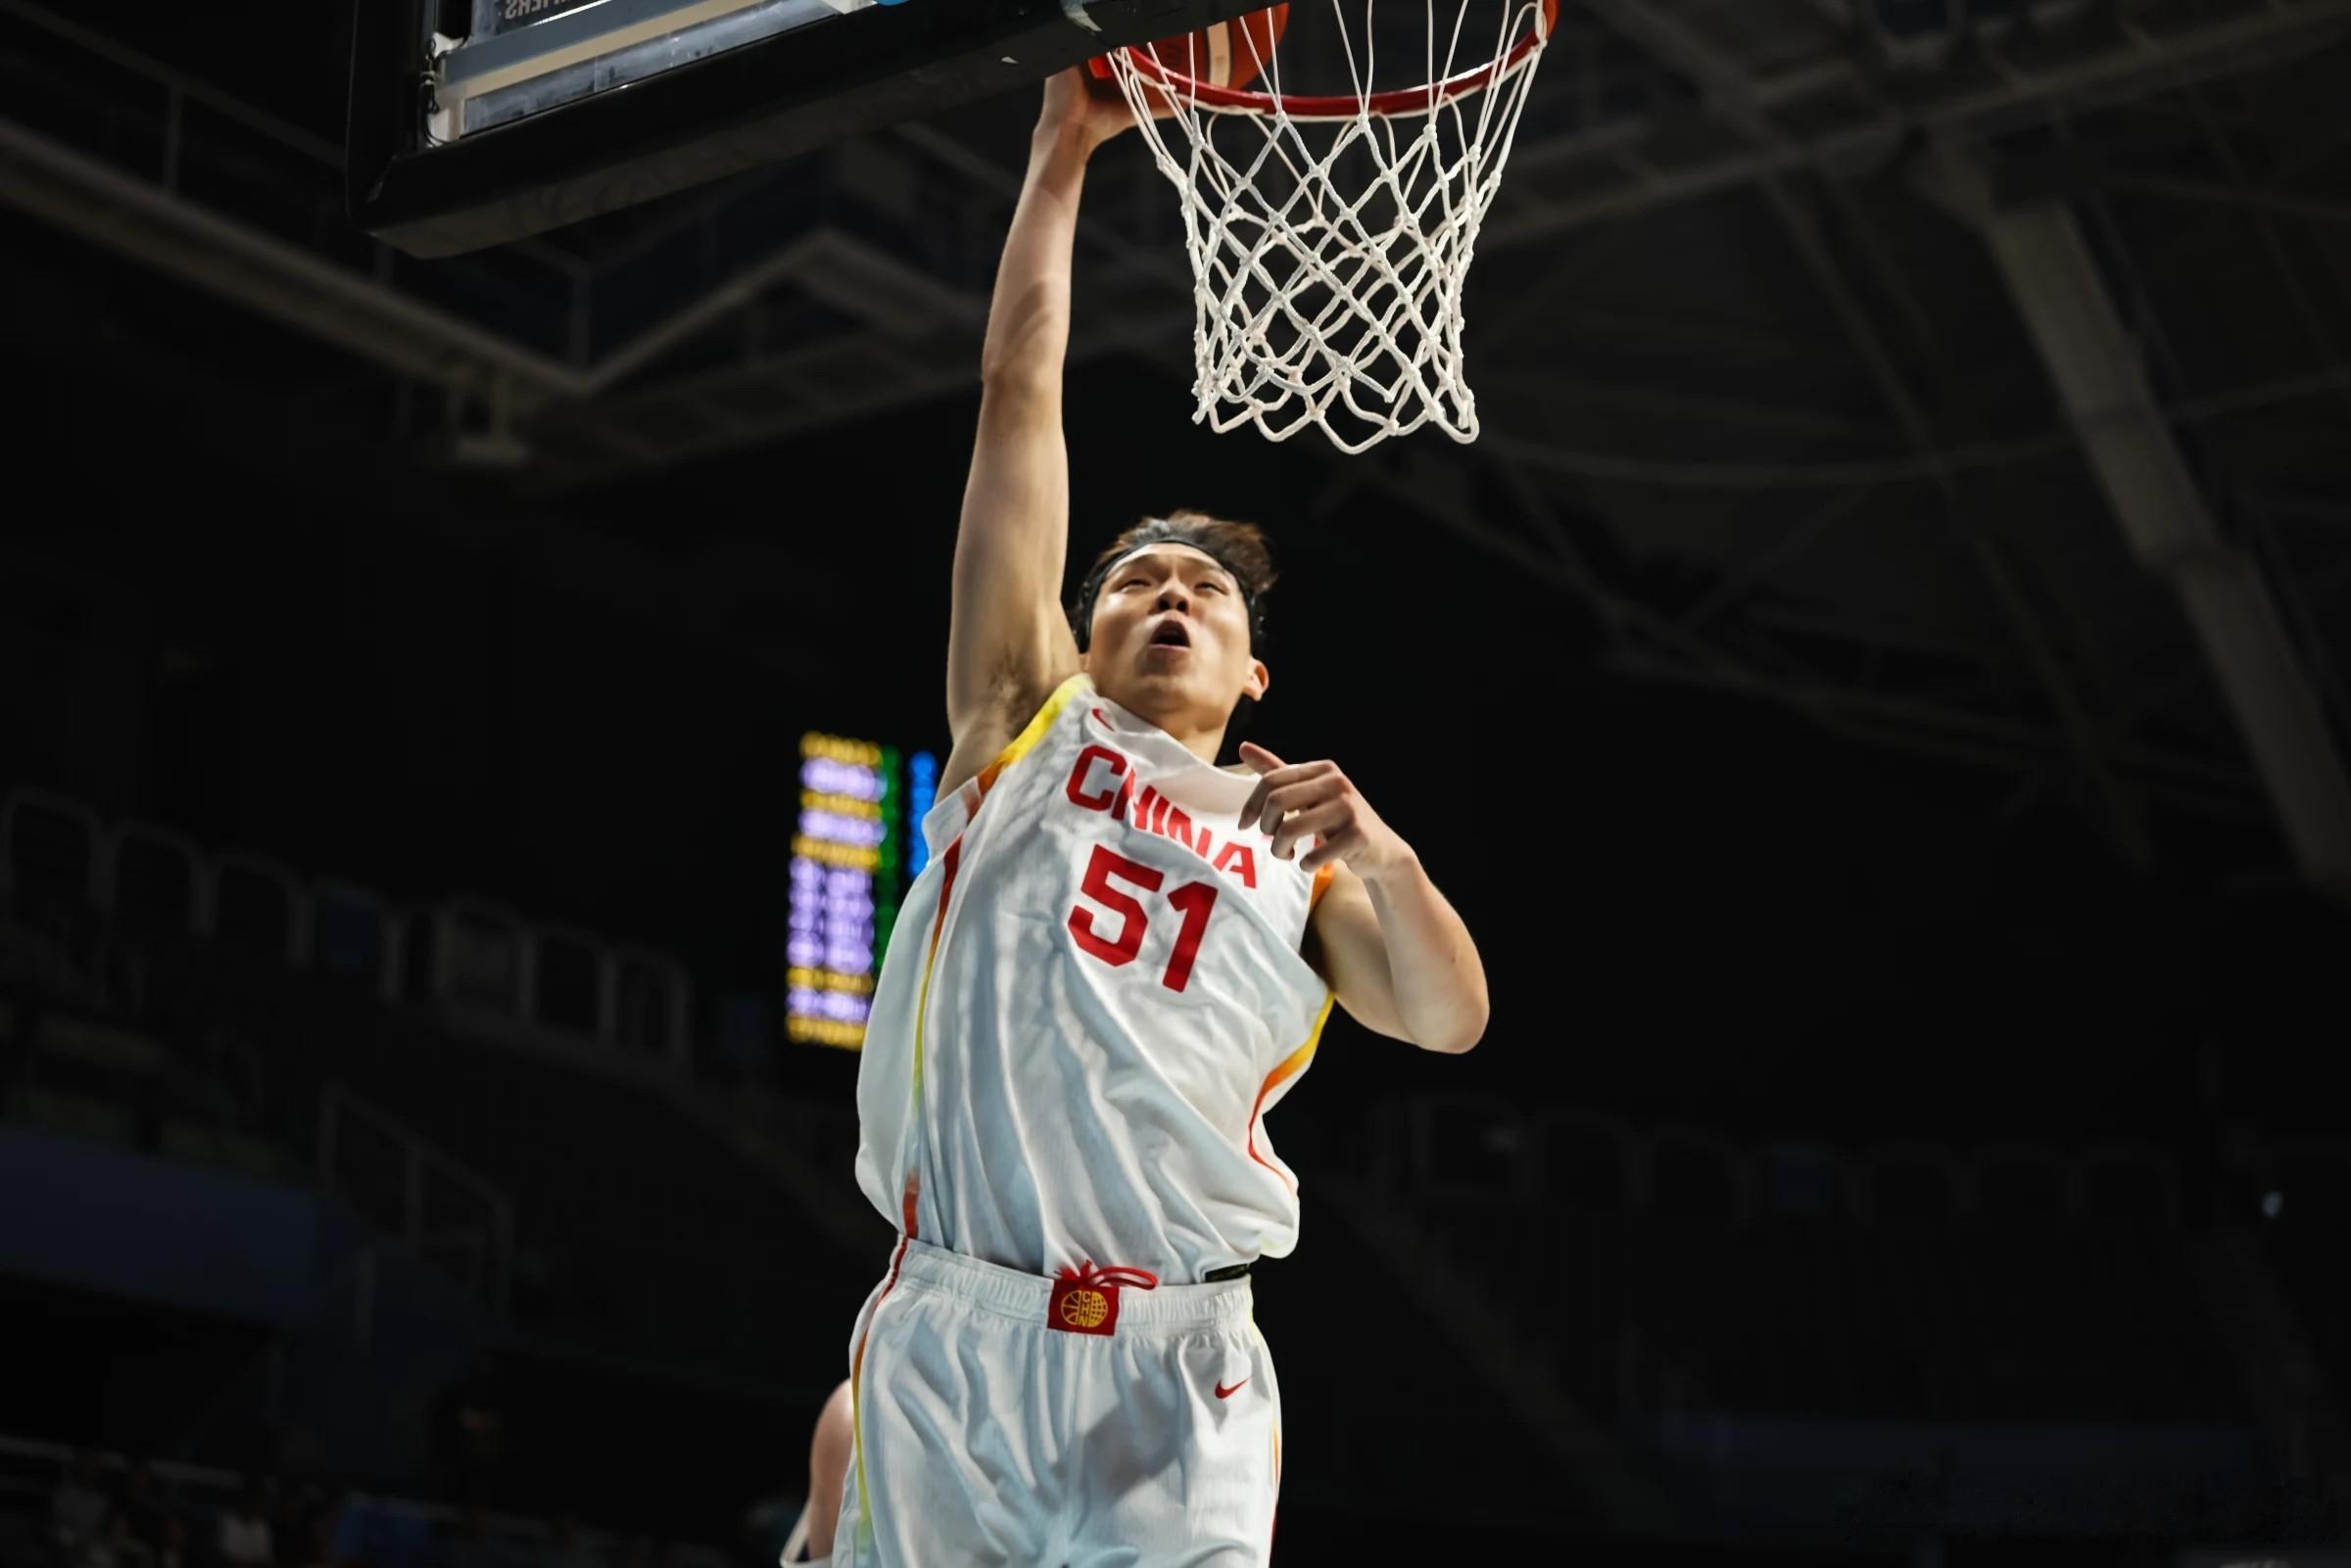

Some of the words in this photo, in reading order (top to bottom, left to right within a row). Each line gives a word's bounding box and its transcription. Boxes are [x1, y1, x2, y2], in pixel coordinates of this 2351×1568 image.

[1066, 744, 1257, 889] CHINA
[1067, 843, 1218, 993] 51
[1079, 1291, 1091, 1327] CHN
